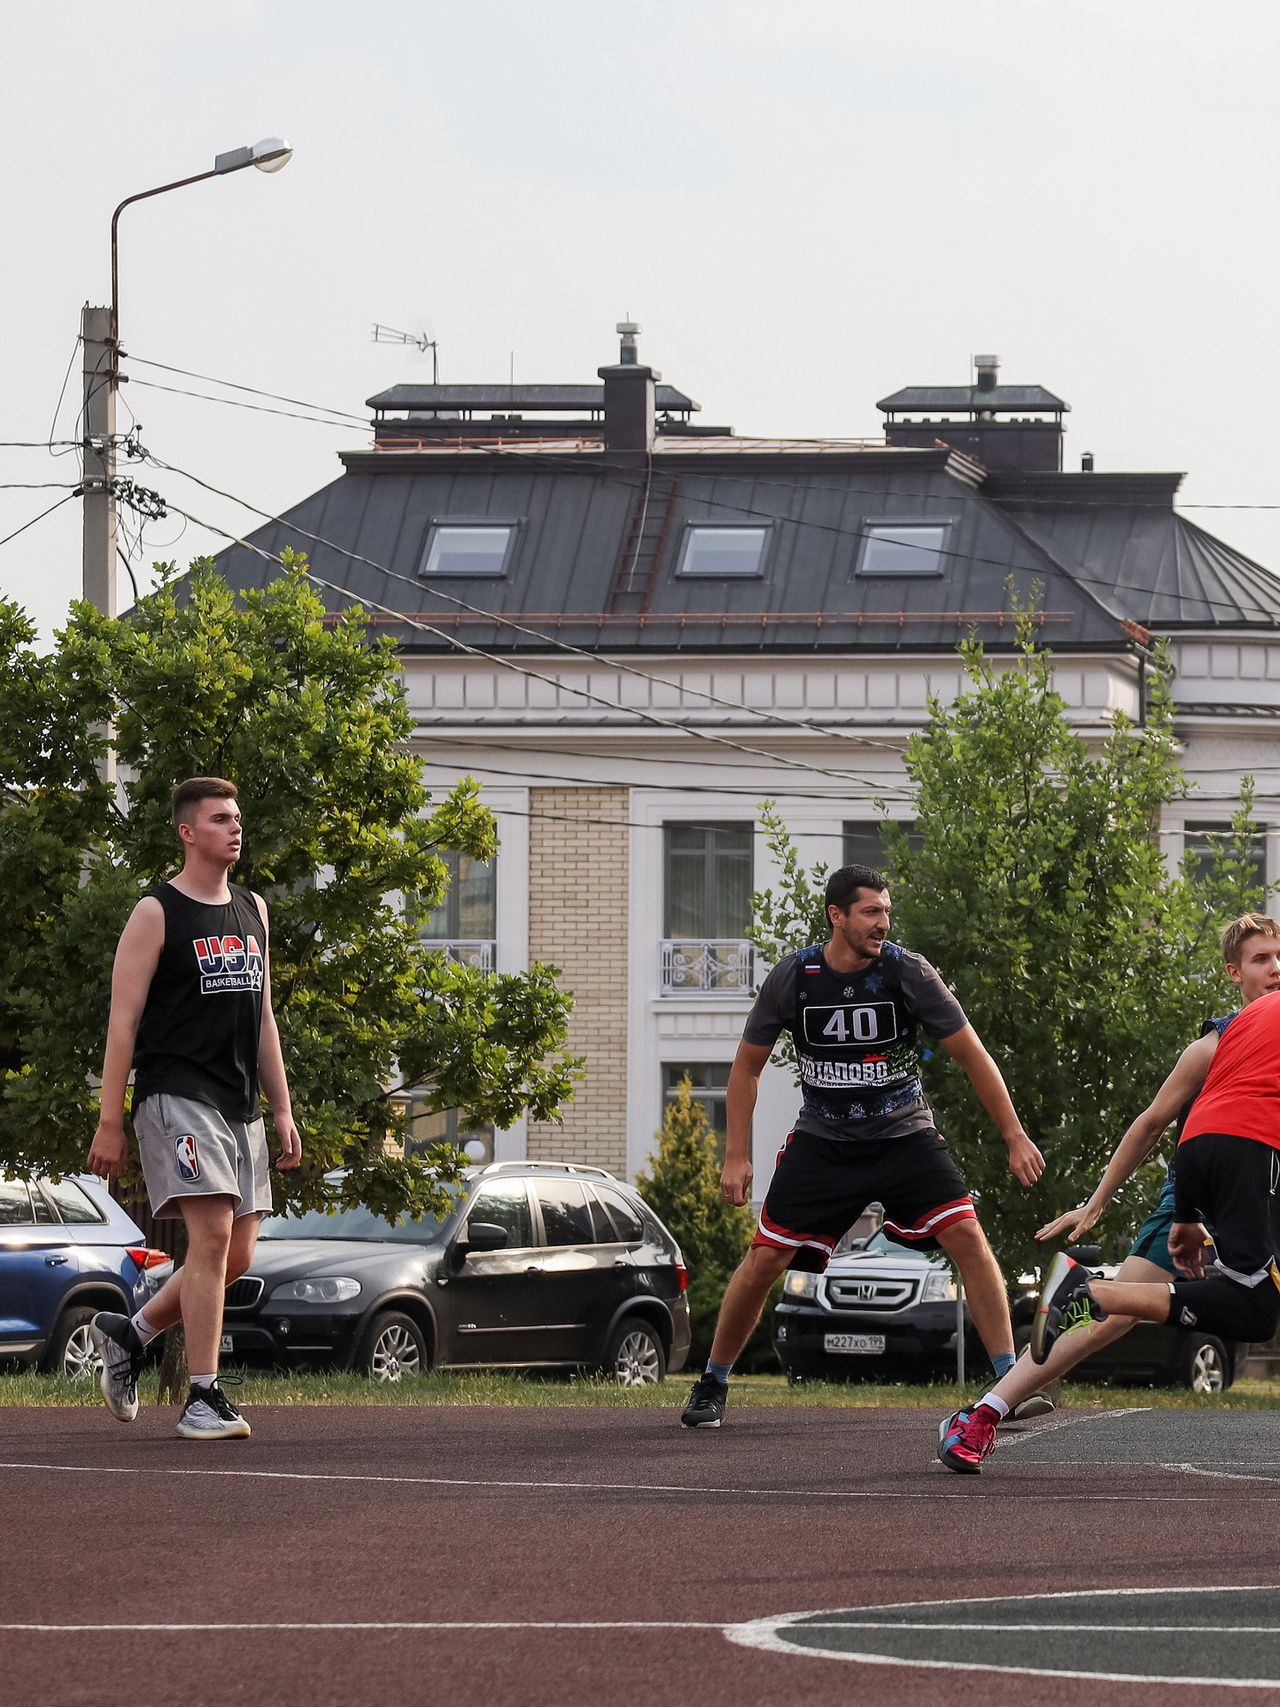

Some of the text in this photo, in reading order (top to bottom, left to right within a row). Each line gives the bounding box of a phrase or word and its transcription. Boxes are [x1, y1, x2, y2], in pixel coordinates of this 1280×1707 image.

[193, 934, 263, 975] USA
[205, 977, 252, 989] BASKETBALL
[822, 1007, 878, 1042] 40
